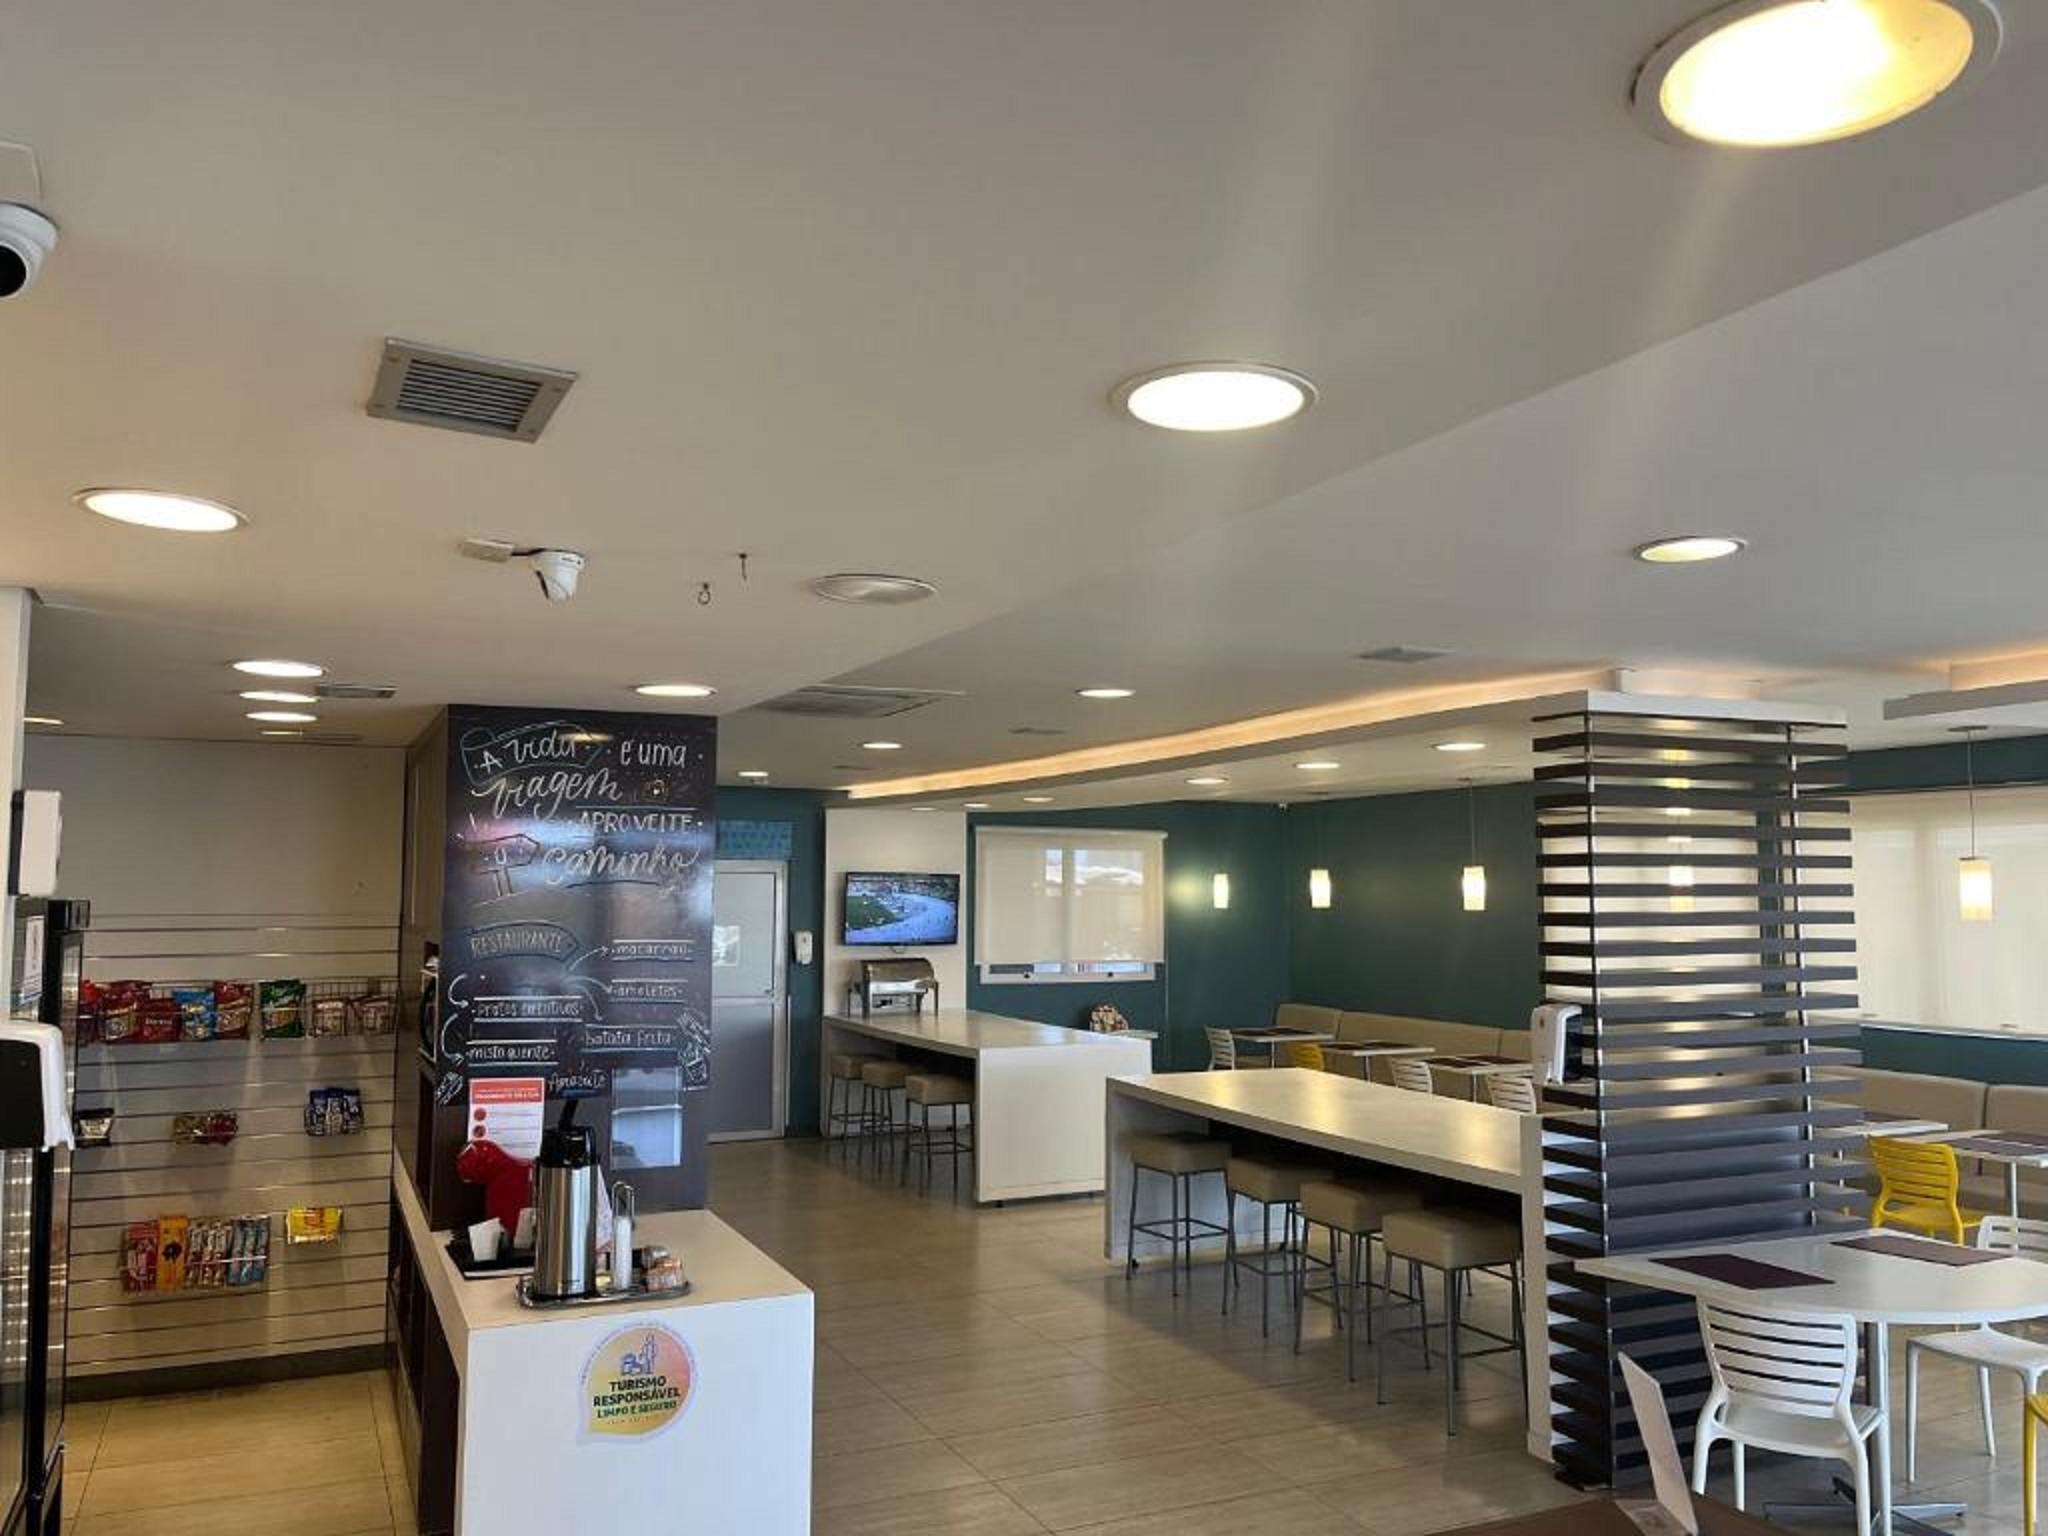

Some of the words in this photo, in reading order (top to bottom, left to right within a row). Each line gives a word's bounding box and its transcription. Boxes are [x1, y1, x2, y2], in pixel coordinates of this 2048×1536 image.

[480, 749, 502, 774] A
[637, 741, 687, 768] uma
[581, 812, 692, 833] APROVEITE
[609, 1376, 666, 1392] TURISMO
[593, 1387, 681, 1408] RESPONSÁVEL
[597, 1405, 629, 1419] LIMPO
[639, 1401, 677, 1413] SEGURO
